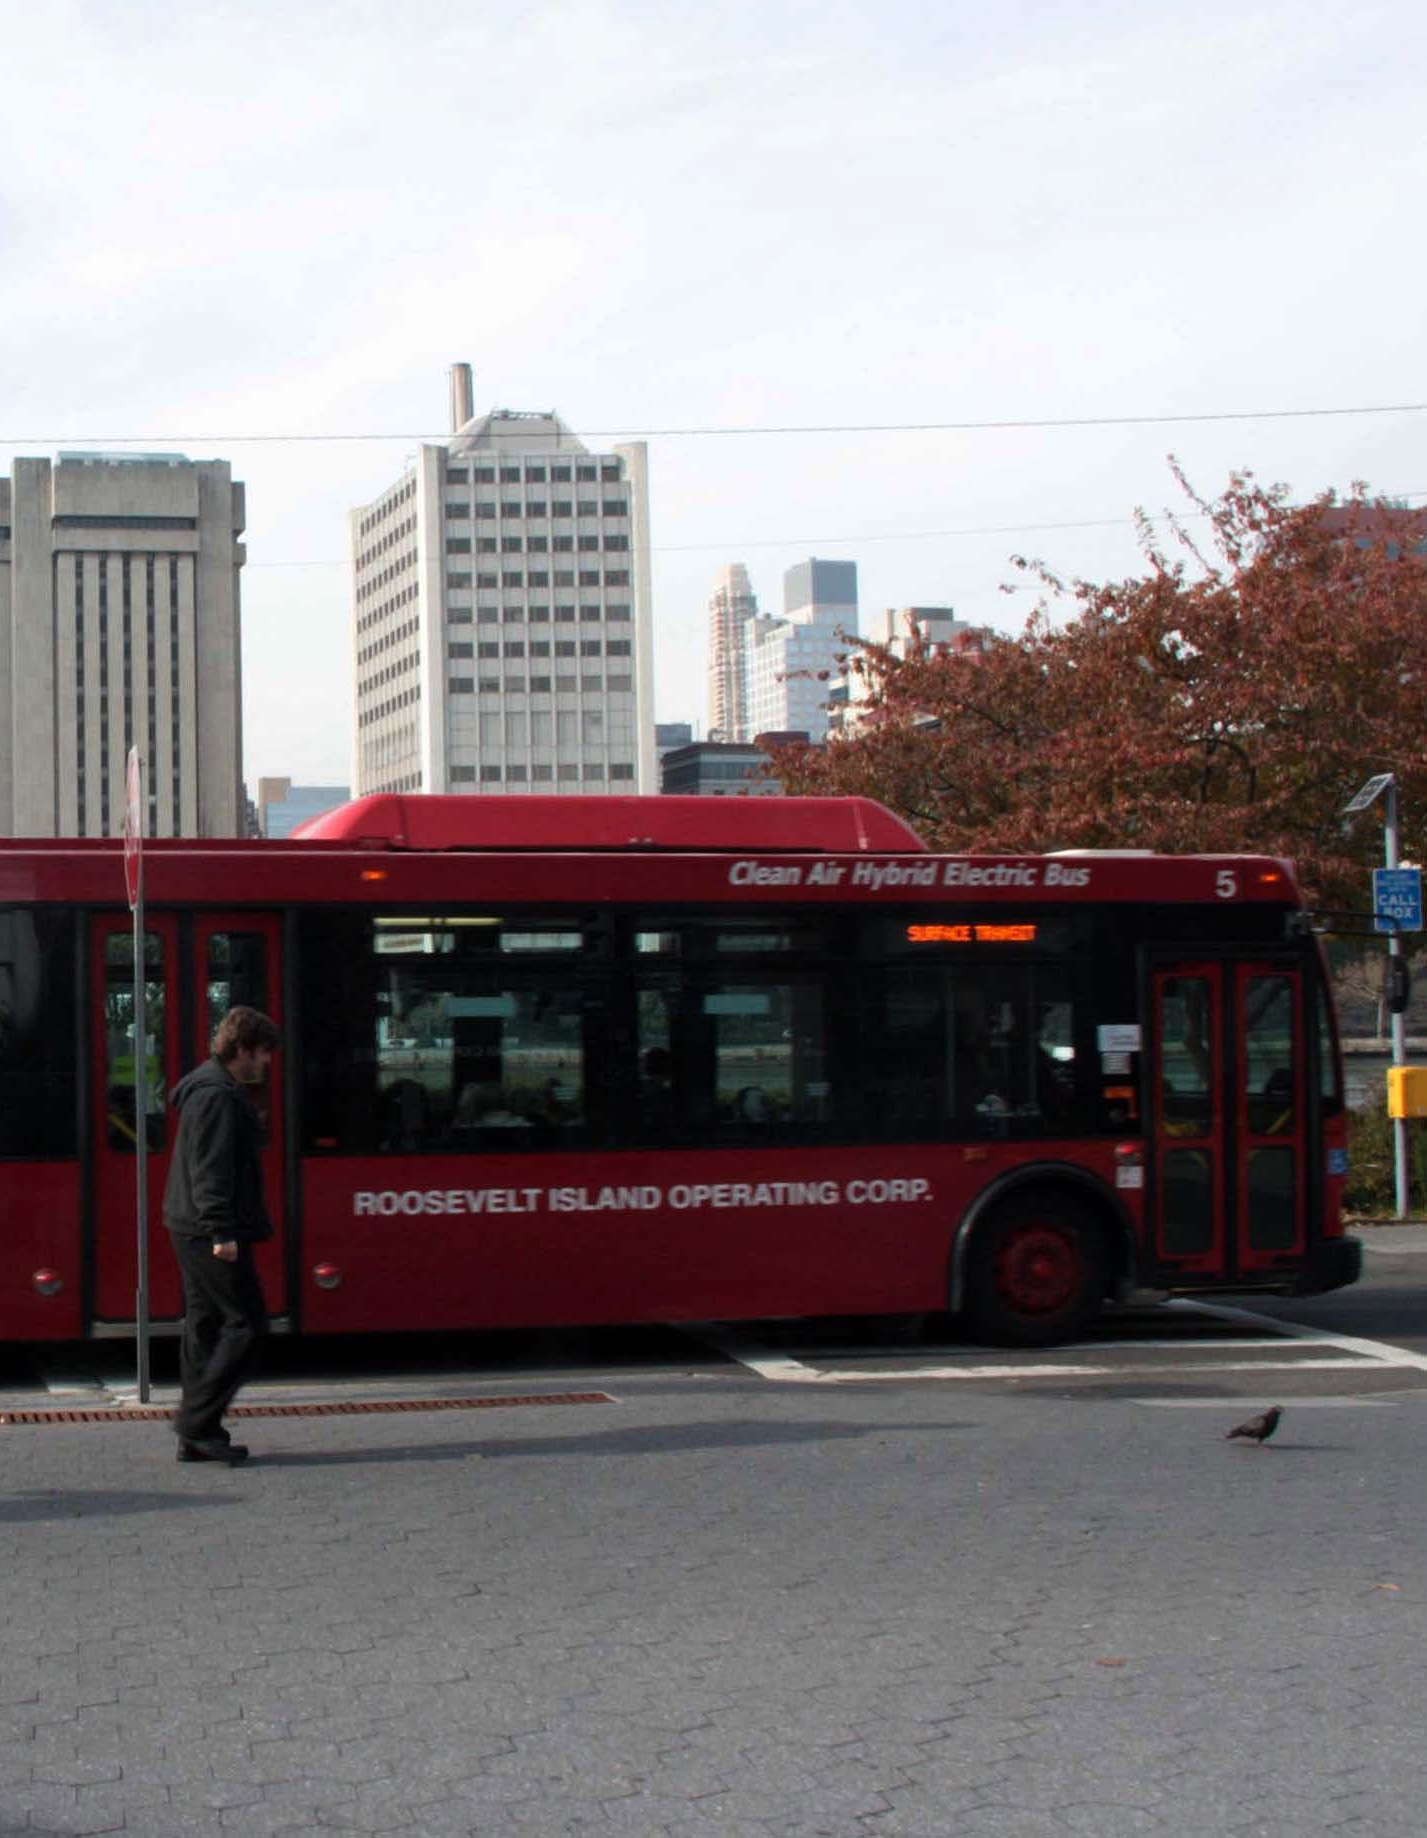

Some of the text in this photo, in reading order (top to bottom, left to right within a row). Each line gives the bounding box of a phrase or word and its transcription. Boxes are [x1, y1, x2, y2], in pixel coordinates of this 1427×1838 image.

[728, 860, 1091, 891] Clean Air Hybrid Electric Bus
[1215, 870, 1236, 898] 5
[1378, 894, 1418, 906] CALL
[1383, 906, 1414, 918] BOX
[353, 1178, 934, 1216] ROOSEVELT ISLAND OPERATING CORP.
